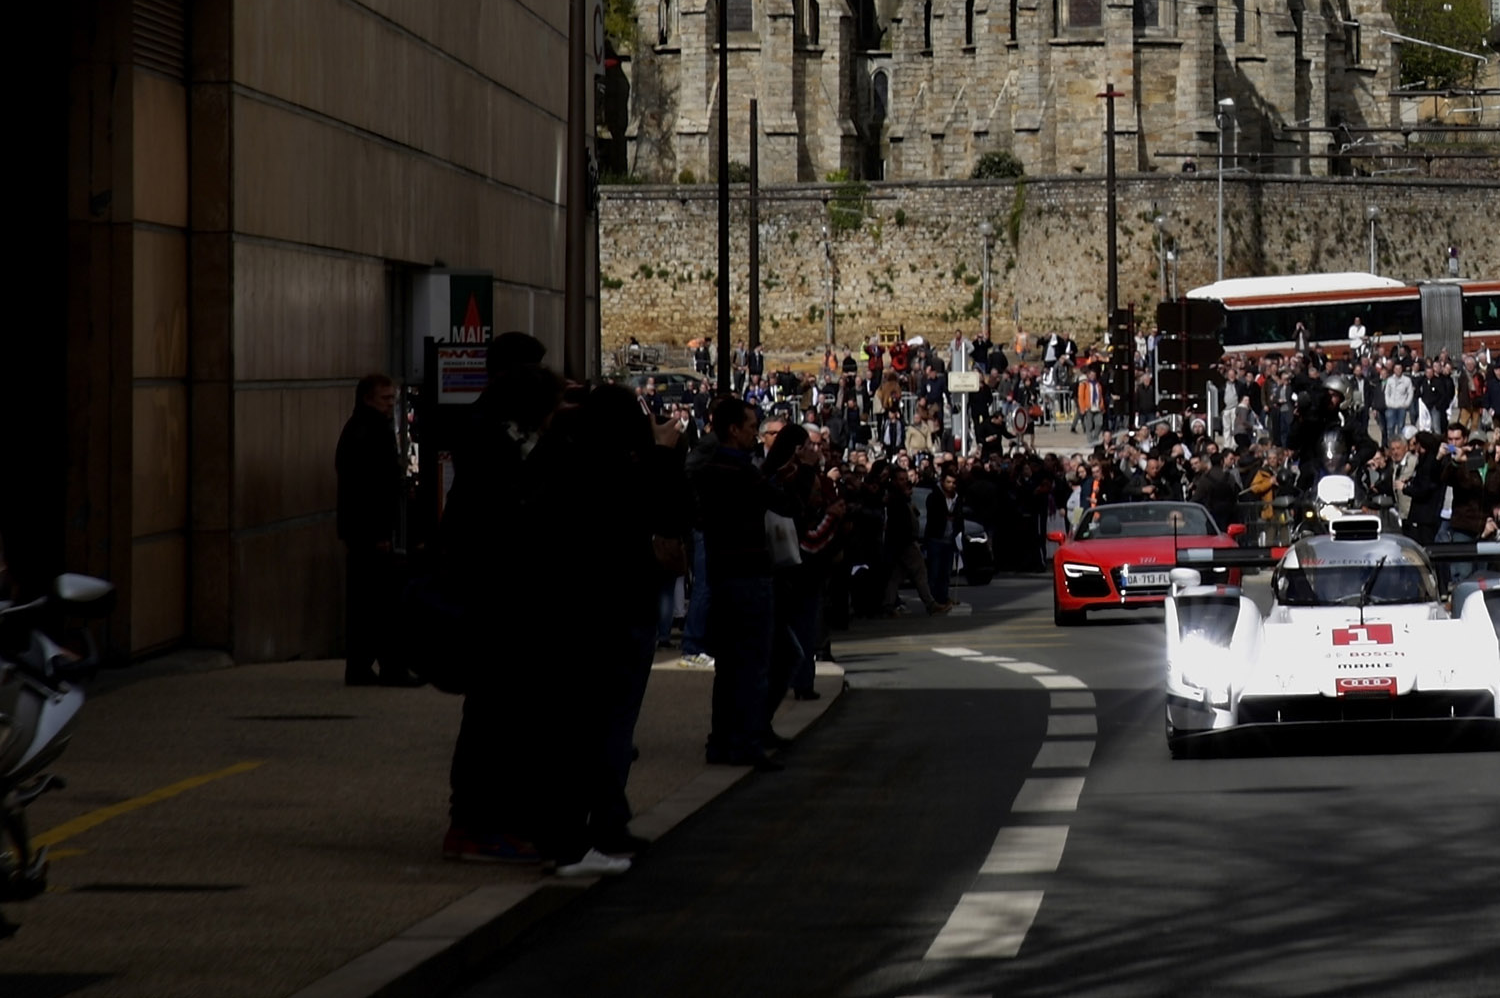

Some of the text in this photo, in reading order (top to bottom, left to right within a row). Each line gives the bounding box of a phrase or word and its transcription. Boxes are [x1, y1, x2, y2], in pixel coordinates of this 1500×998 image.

[452, 325, 491, 344] MAIF
[1348, 628, 1378, 645] 1
[1349, 650, 1406, 658] BOSCH
[1337, 662, 1393, 670] MAHLE
